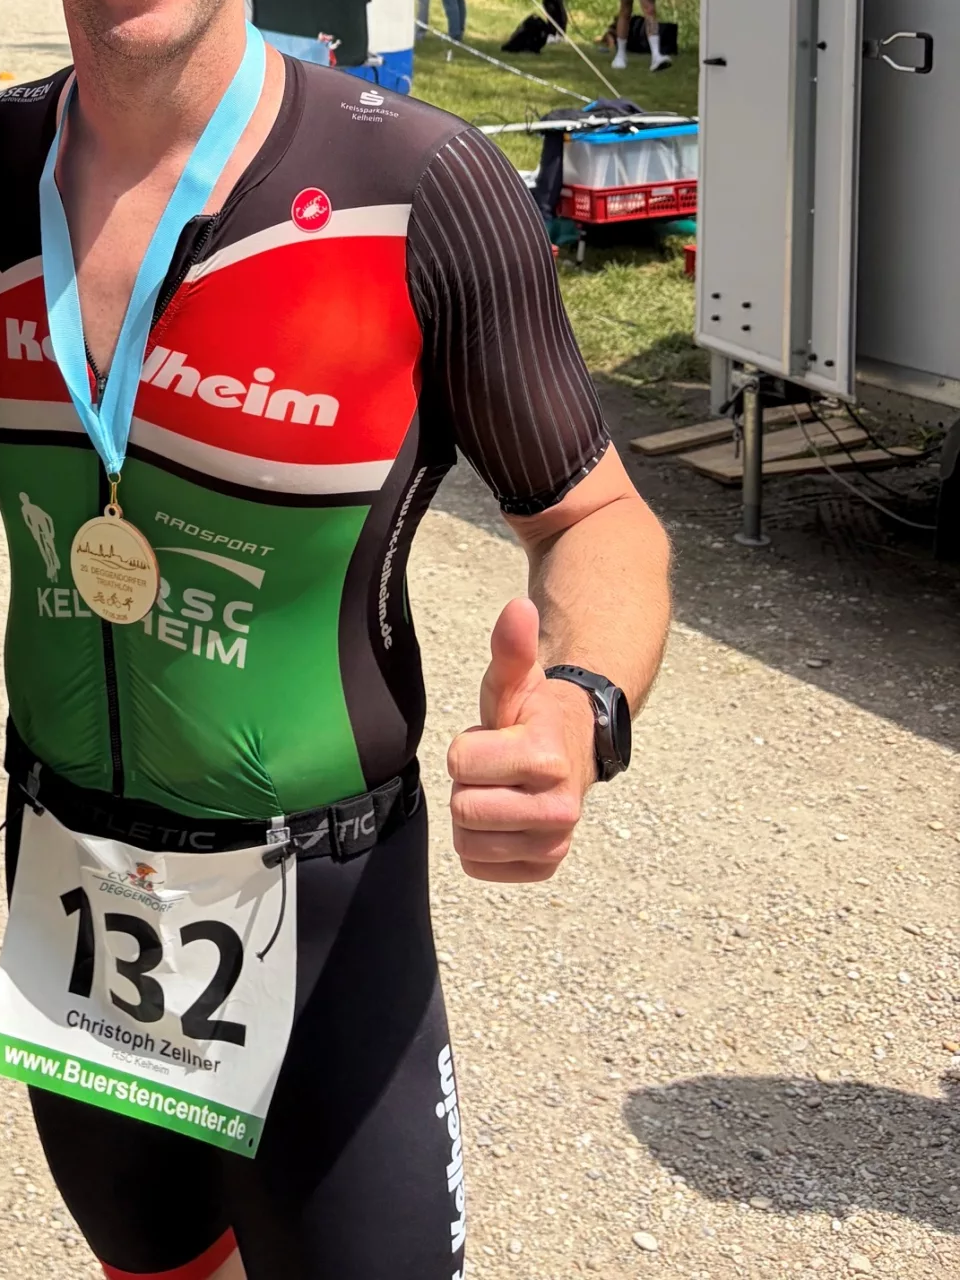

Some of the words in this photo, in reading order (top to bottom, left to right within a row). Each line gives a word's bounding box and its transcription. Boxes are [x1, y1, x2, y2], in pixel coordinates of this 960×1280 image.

[4, 81, 54, 98] SEVEN
[340, 101, 400, 118] Kreissparkasse
[352, 113, 383, 123] Kelheim
[154, 510, 276, 557] RADSPORT
[98, 882, 174, 914] DEGGENDORF
[60, 886, 247, 1048] 132
[66, 1009, 155, 1053] Christoph
[160, 1039, 221, 1074] Zellner
[112, 1050, 132, 1065] RSC
[134, 1057, 170, 1076] Kelheim
[4, 1044, 247, 1140] www.Buerstencenter.de
